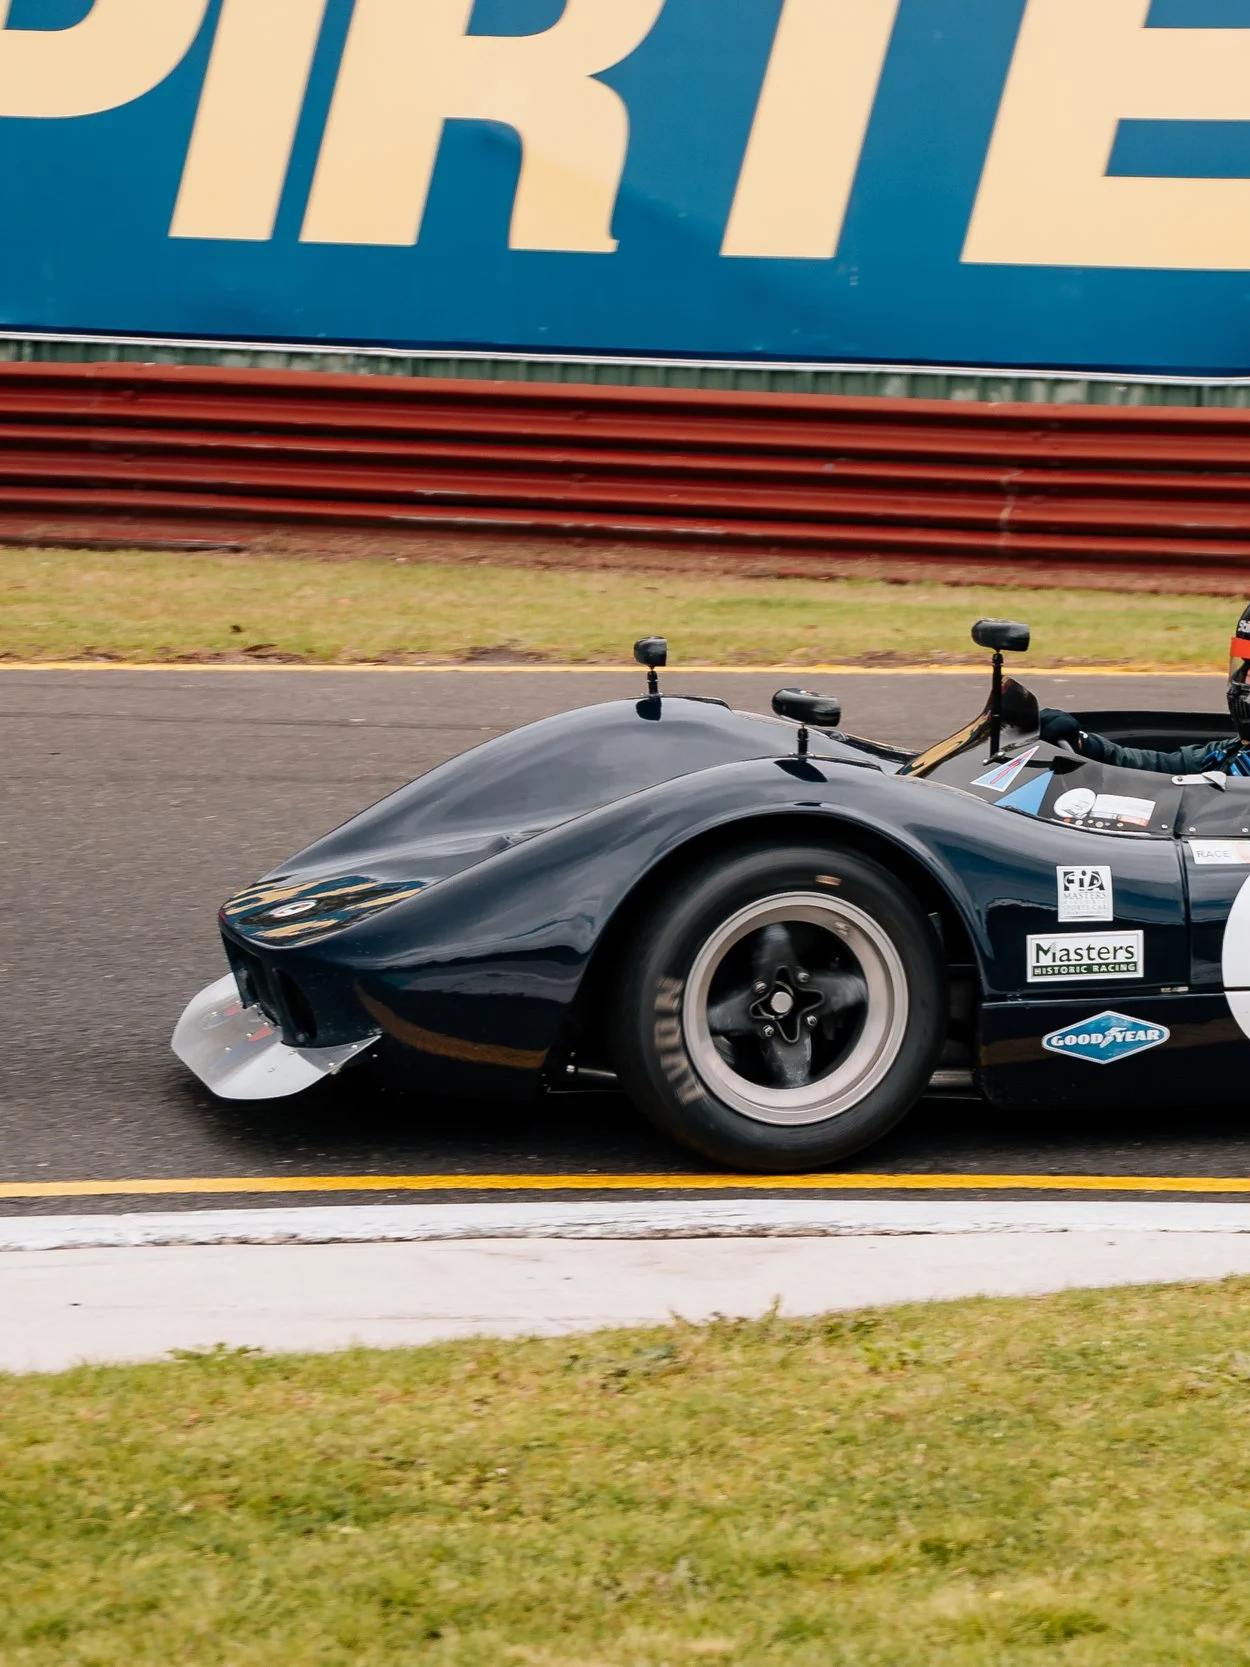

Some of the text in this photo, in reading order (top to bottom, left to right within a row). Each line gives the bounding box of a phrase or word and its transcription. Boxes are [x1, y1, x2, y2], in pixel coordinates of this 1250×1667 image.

[1196, 849, 1231, 858] RACE
[1063, 892, 1107, 900] MASTERS
[1035, 942, 1135, 963] Masters
[1034, 963, 1136, 975] HISTORIC RACING
